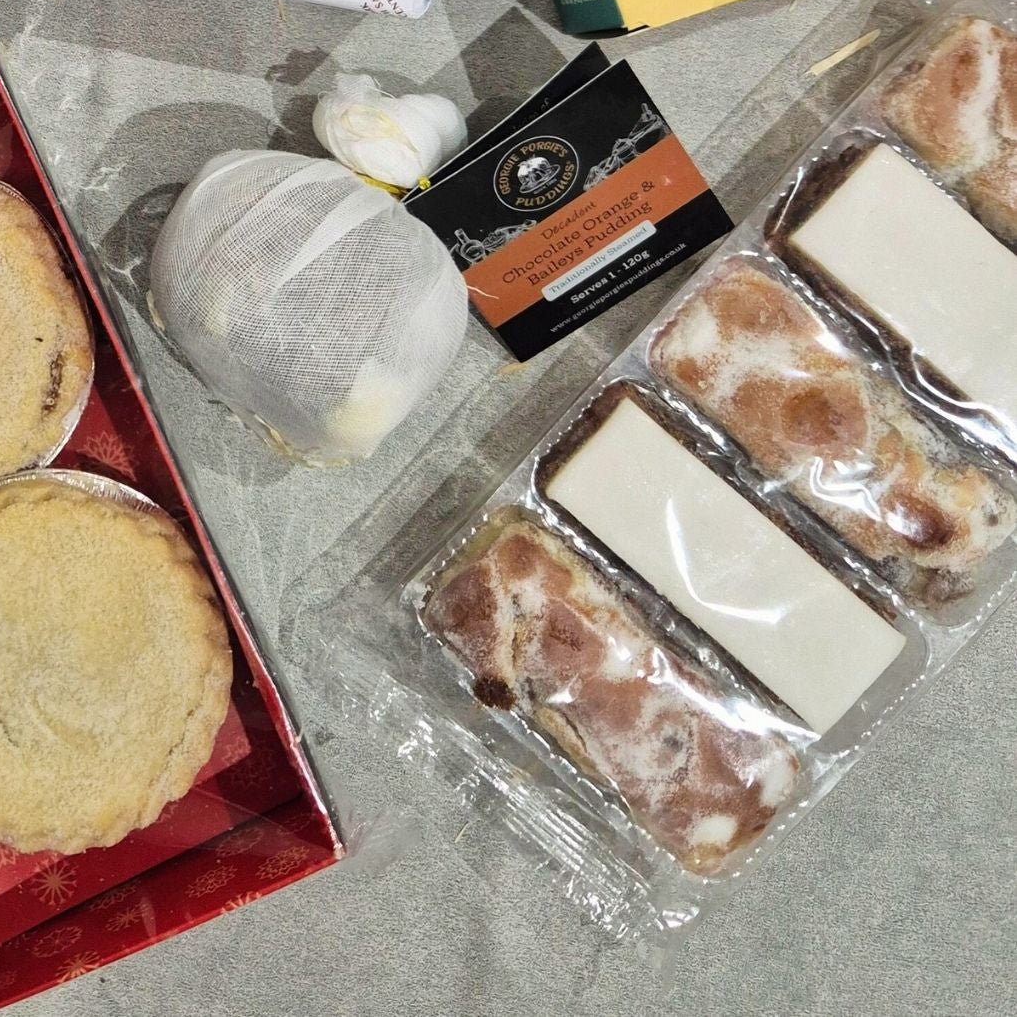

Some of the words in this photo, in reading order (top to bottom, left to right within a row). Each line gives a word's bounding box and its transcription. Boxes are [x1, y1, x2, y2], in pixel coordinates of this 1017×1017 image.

[499, 153, 519, 195] GEORGIE
[520, 141, 568, 158] PORGIE'S
[515, 164, 575, 206] PUDDINGS
[502, 230, 581, 284] Chocolate
[582, 190, 639, 231] Orange
[641, 180, 655, 193] &
[527, 248, 584, 286] Baileys
[584, 201, 653, 249] Pudding
[548, 254, 606, 294] Traditionally
[607, 227, 648, 257] Steamed
[570, 274, 608, 304] Serves
[622, 249, 651, 271] 120g
